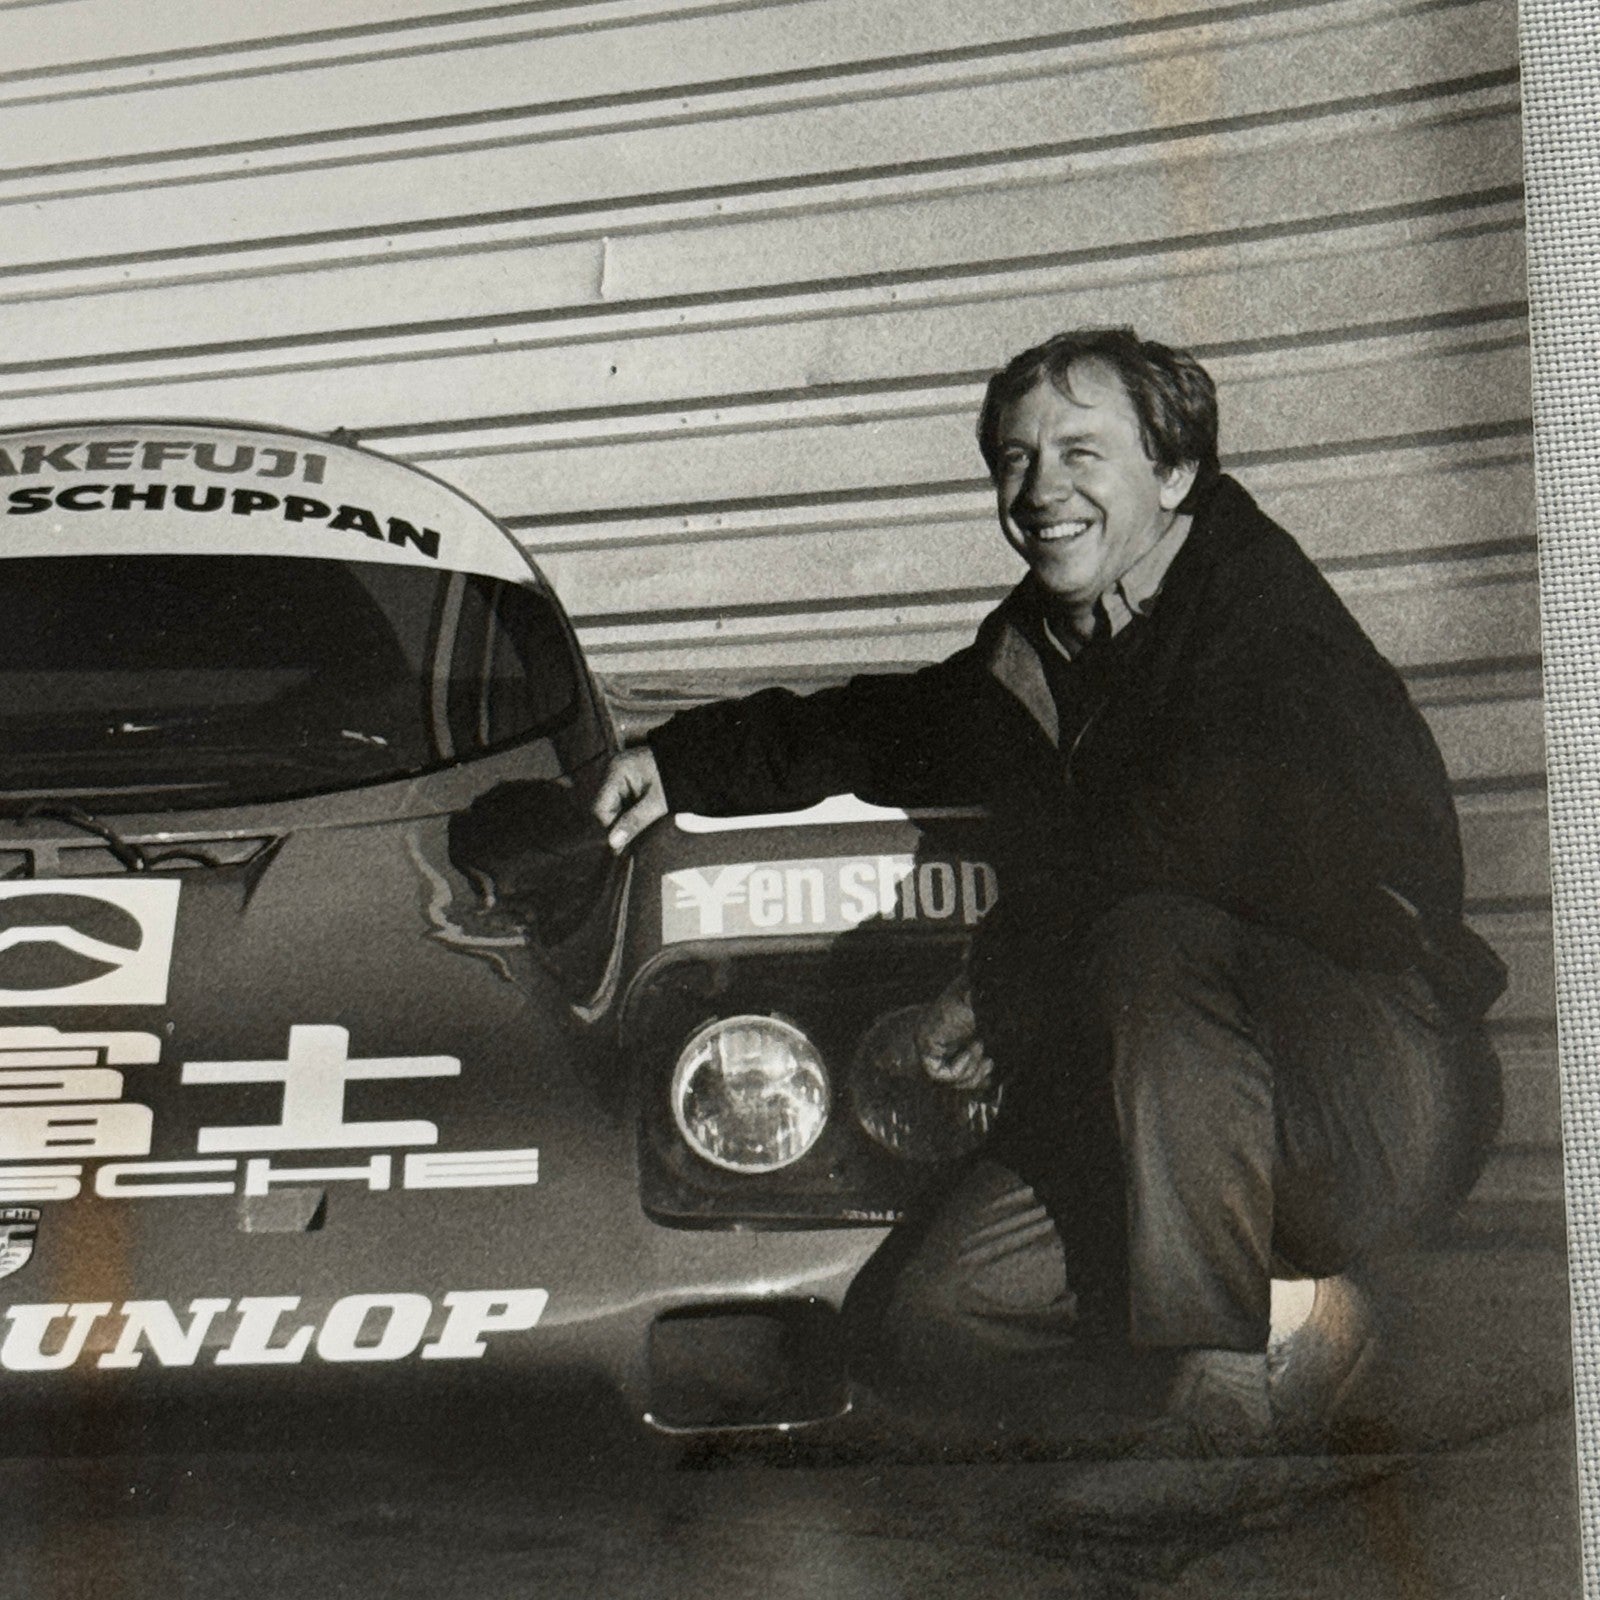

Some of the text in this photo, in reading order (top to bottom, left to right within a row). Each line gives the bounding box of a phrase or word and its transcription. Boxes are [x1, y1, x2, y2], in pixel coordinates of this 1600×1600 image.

[7, 484, 441, 559] SCHUPPAN
[838, 853, 998, 924] shop
[0, 1288, 549, 1371] UNLOP
